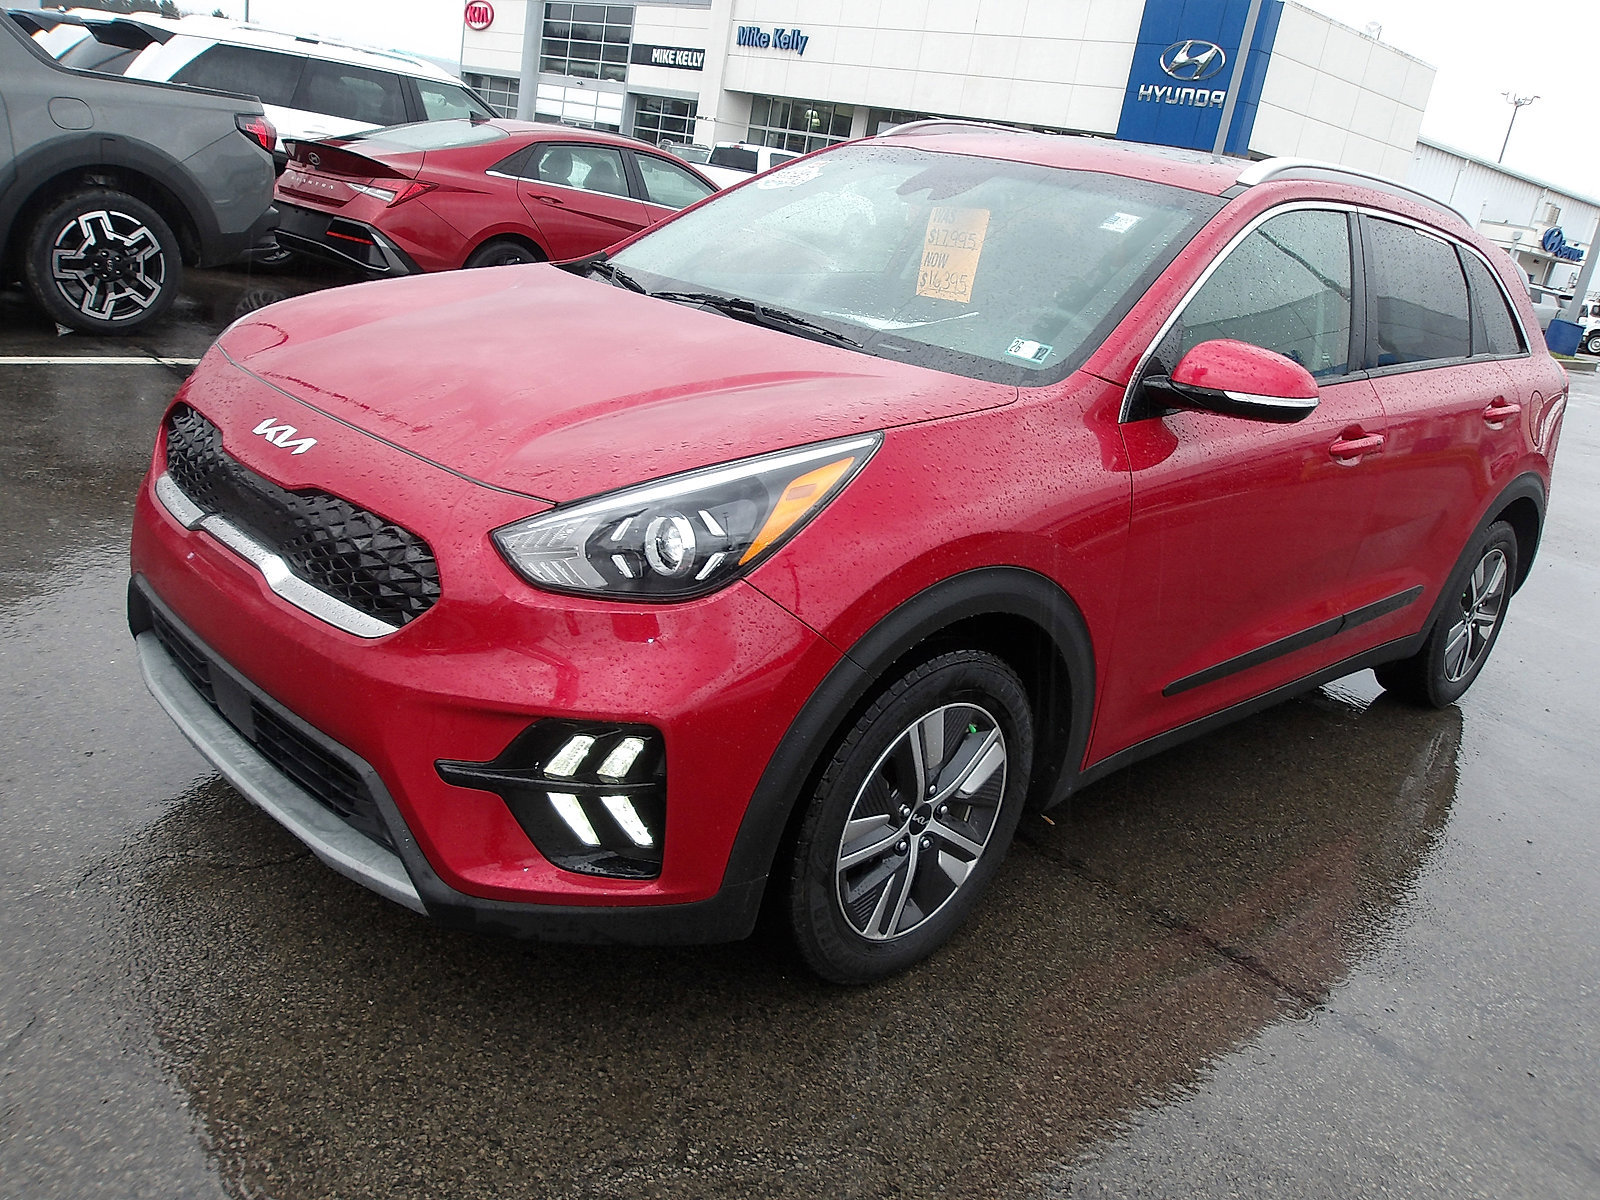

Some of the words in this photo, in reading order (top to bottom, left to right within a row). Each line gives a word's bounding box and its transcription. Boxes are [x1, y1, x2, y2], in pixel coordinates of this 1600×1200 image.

[468, 5, 489, 24] KIA
[736, 26, 770, 48] Mike
[772, 28, 809, 56] Kelly
[651, 48, 675, 65] MIKE
[675, 51, 704, 67] KELLY
[1138, 84, 1226, 108] HYUNDA
[932, 207, 957, 224] WAS
[923, 251, 949, 269] NOW
[1009, 340, 1025, 353] 26
[1031, 346, 1049, 361] 12
